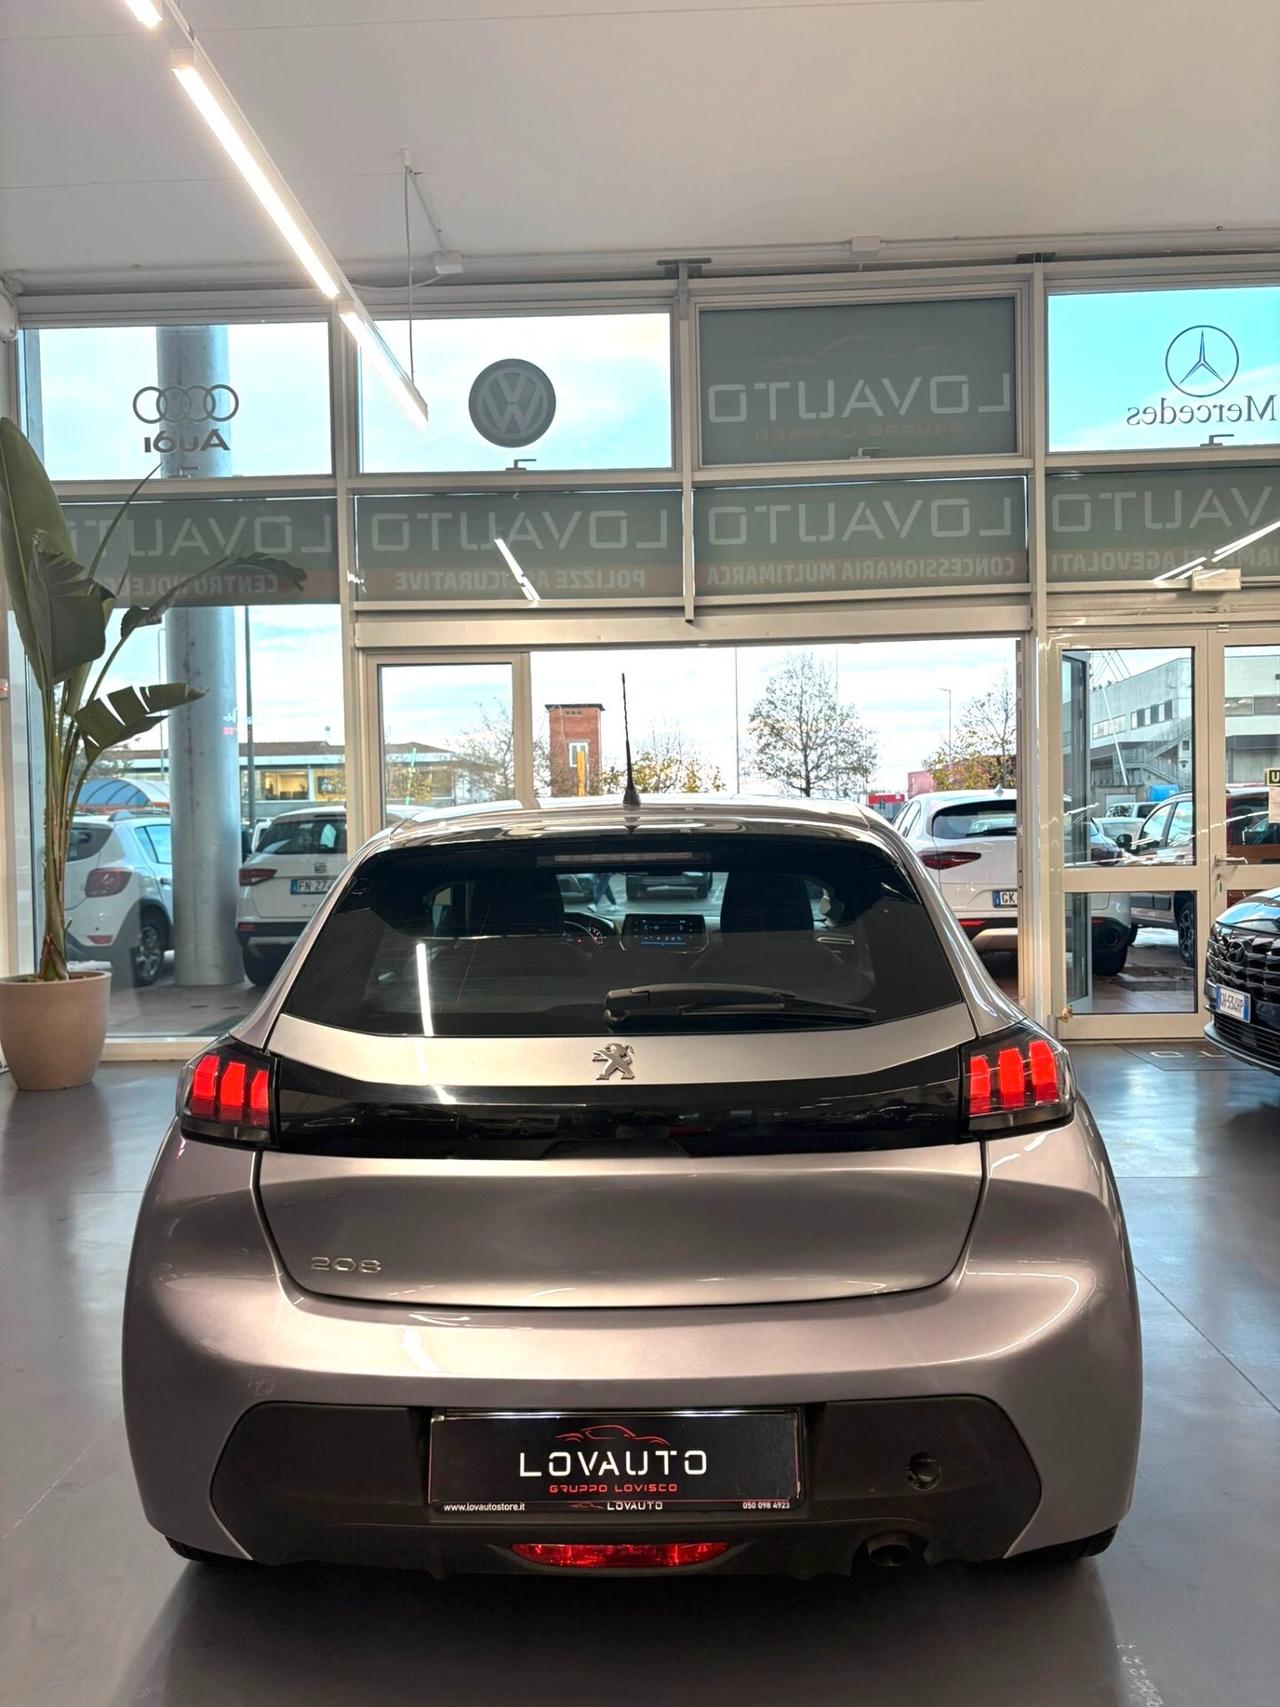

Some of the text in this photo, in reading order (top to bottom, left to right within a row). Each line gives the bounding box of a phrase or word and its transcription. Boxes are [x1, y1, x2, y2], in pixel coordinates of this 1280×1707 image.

[311, 1256, 381, 1273] 208
[519, 1449, 708, 1478] LOVAUTO
[549, 1482, 678, 1494] GRUPPO LOVISCO
[443, 1501, 526, 1512] www.lovautostore.it
[606, 1501, 664, 1511] LOVAUTO
[742, 1501, 757, 1510] 050
[772, 1501, 791, 1510] 4923
